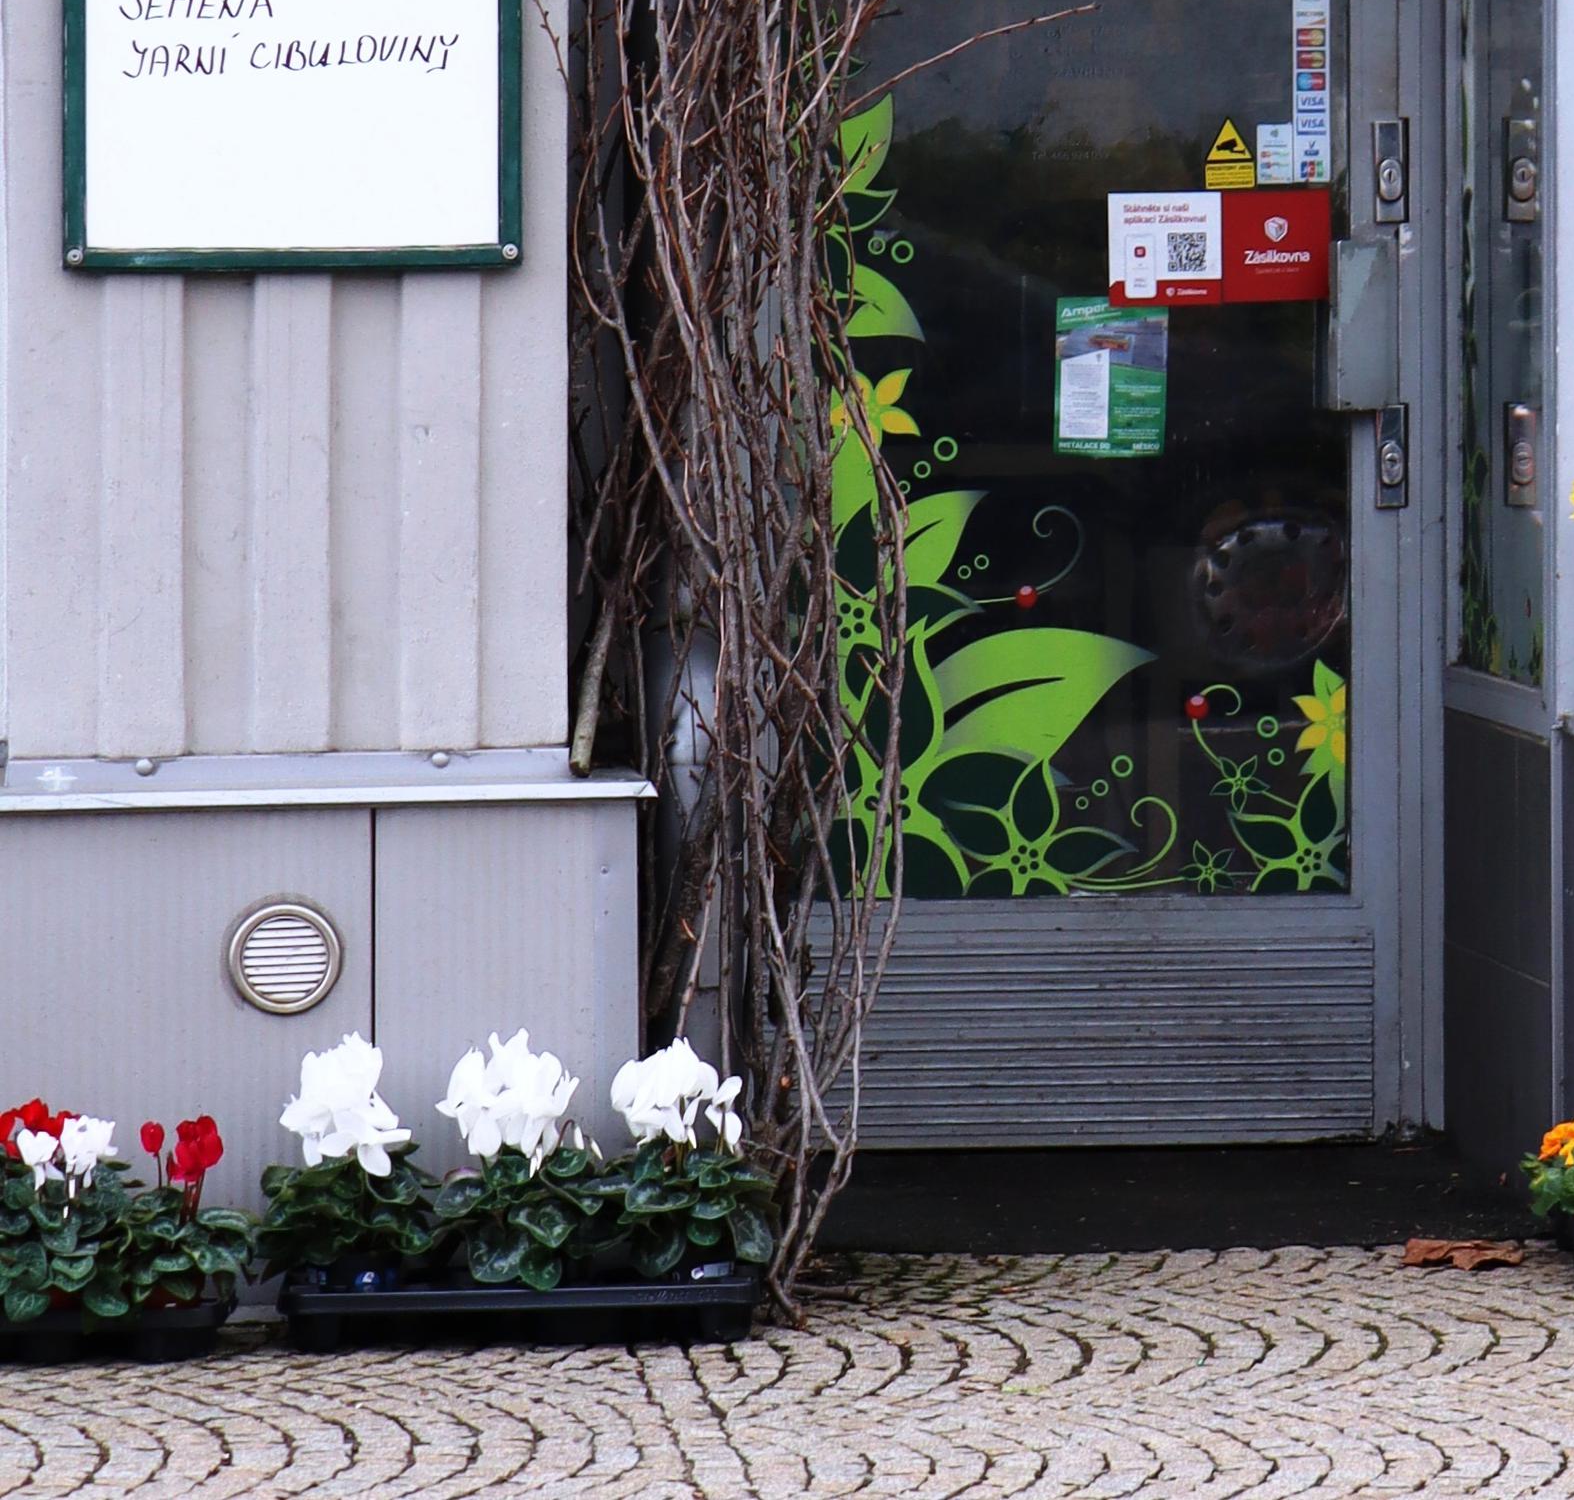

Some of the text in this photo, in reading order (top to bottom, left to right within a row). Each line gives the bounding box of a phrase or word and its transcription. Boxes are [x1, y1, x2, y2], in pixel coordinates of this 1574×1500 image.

[250, 34, 459, 73] CIBULOVINY
[1301, 96, 1325, 106] VISA
[1301, 118, 1325, 128] VISA
[1244, 249, 1311, 265] Zásilkovna
